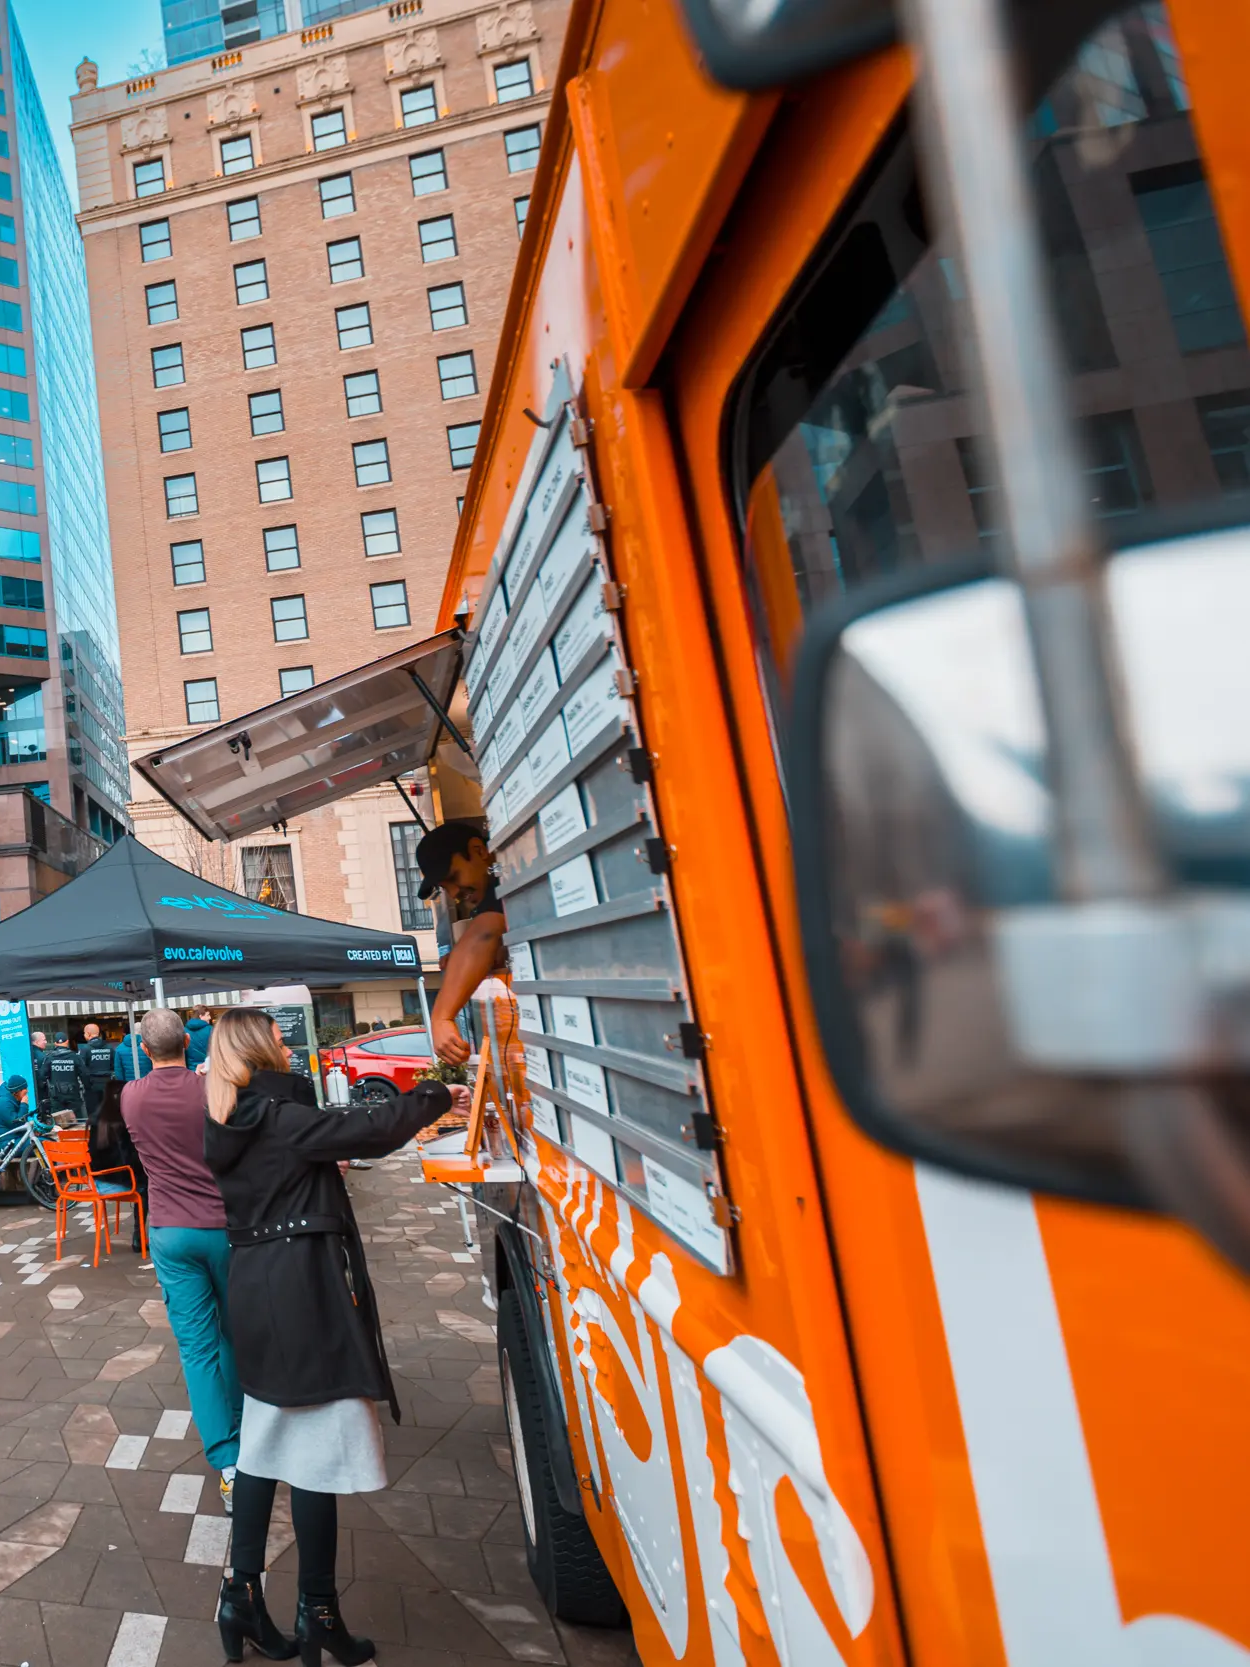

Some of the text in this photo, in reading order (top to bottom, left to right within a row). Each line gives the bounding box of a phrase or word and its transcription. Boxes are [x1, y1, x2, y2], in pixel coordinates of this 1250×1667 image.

[155, 894, 287, 916] evolve
[163, 945, 244, 962] evo.ca/evolve
[347, 949, 414, 961] CREATED BY BCAA
[51, 1064, 75, 1072] POLICE
